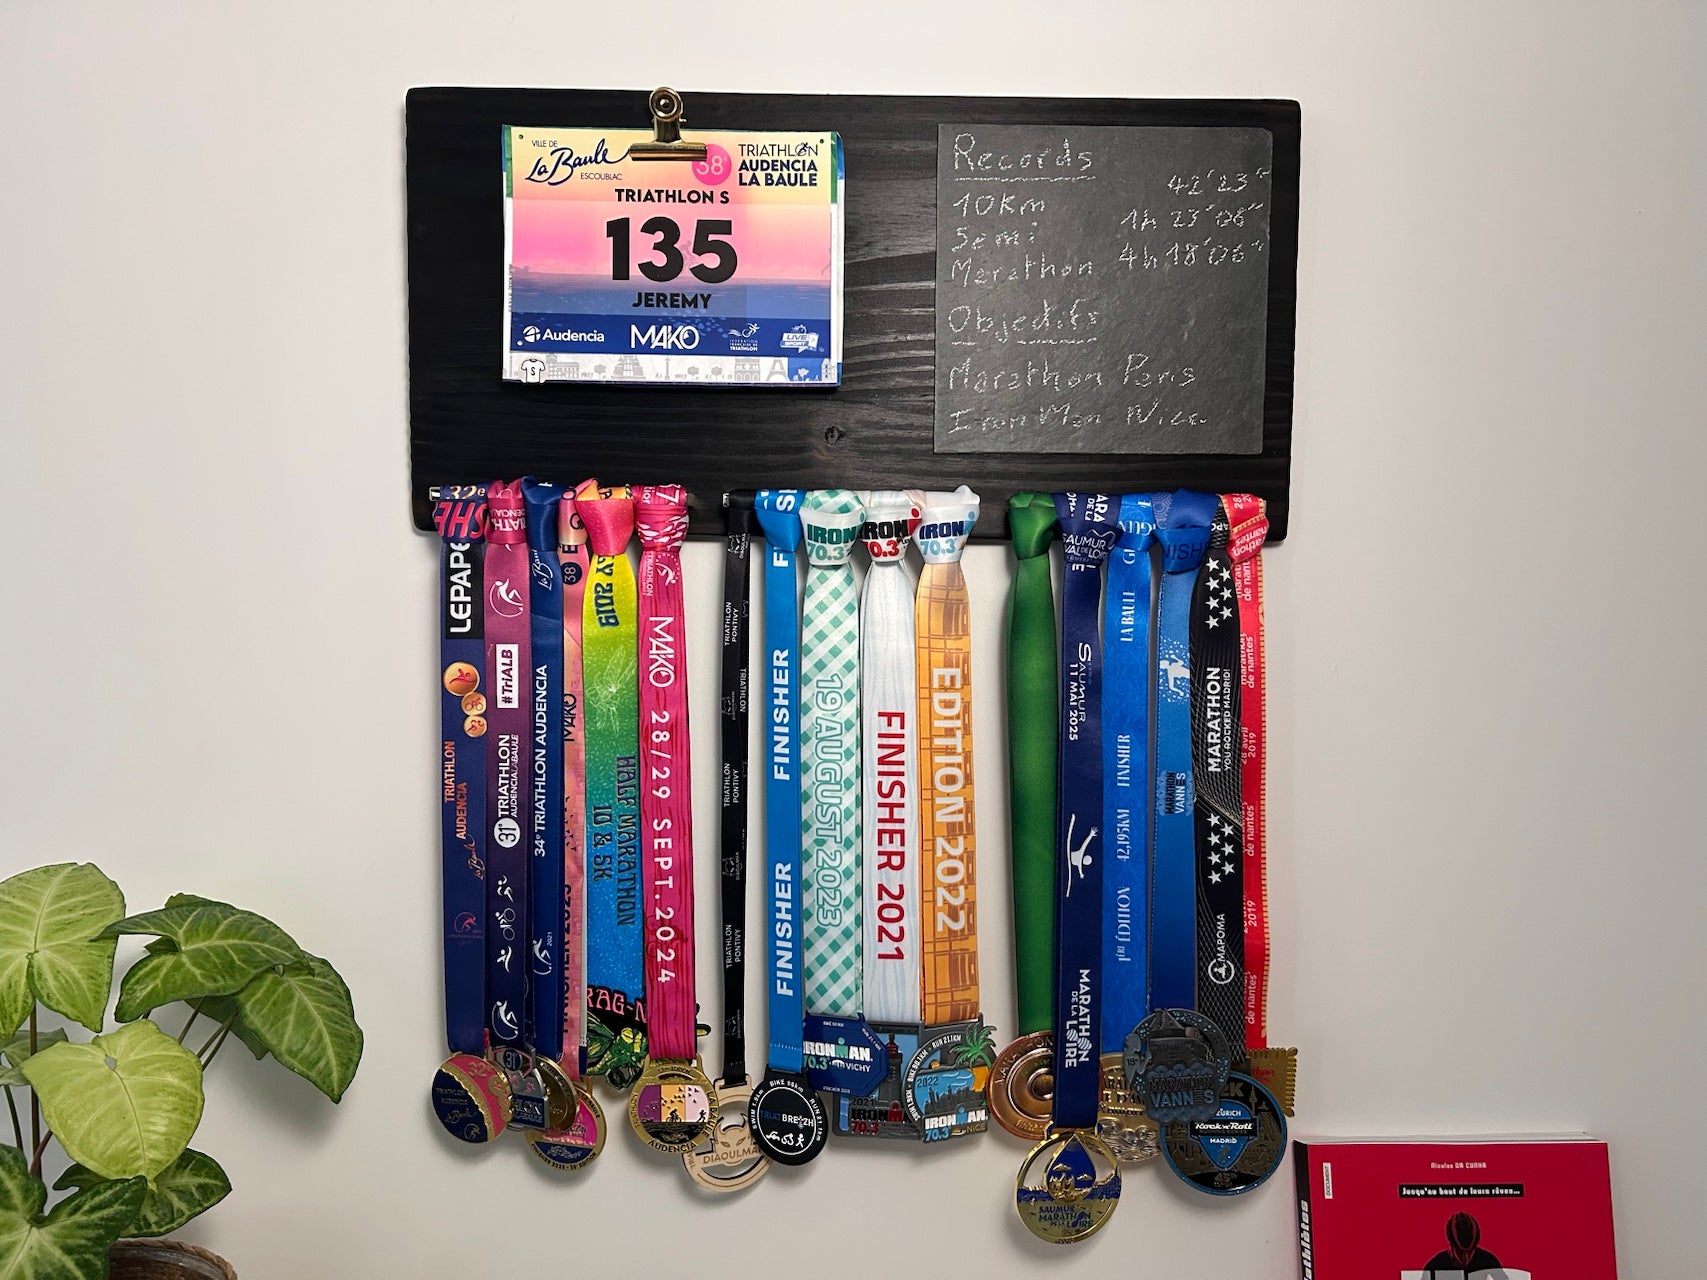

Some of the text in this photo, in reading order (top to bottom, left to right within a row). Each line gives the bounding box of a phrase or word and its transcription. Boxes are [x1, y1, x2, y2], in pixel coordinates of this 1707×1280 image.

[531, 139, 558, 148] VILLE DE
[739, 142, 818, 158] TRIATHLON
[953, 133, 1093, 172] Records
[524, 138, 630, 186] La Baule
[580, 172, 623, 181] ESCOUBLAC
[738, 159, 818, 173] AUDENCIA
[615, 188, 730, 205] TRIATHLON S
[738, 173, 818, 187] LA BAULE
[606, 216, 738, 284] 135
[951, 221, 1038, 253] Semi
[950, 251, 1093, 287] Marathon
[1118, 242, 1158, 270] 4h
[632, 291, 712, 310] JEREMY
[542, 328, 605, 343] Audencia
[630, 324, 700, 350] MAKO
[530, 366, 536, 376] S
[949, 353, 1197, 393] Marathon Paris
[808, 542, 844, 561] 70.3
[919, 538, 956, 556] 70.3
[564, 566, 577, 583] 38
[594, 581, 620, 629] 2019
[1242, 588, 1252, 601] de
[724, 601, 732, 646] TRIATHLON
[731, 607, 739, 643] PONTIVY
[1120, 590, 1135, 642] LA BAULE
[648, 616, 675, 688] MAKO
[501, 648, 513, 705] #TriALB
[739, 667, 747, 713] TRIATHLON
[1078, 643, 1092, 723] SAUMUR
[1247, 674, 1254, 689] de
[535, 664, 548, 746] AUDENCIA
[773, 648, 790, 781] FINISHER
[1068, 662, 1079, 741] 11 MAI 2025
[1206, 667, 1221, 773] MARATHON
[1223, 668, 1231, 772] YOU ROCKED MADRID!
[1116, 733, 1131, 788] FINISHER
[1247, 732, 1256, 758] 2019
[444, 740, 456, 803] TRIATHLON
[498, 734, 511, 818] TRIATHLON
[723, 763, 731, 808] TRIATHLON
[732, 768, 740, 804] PONTIVY
[534, 749, 547, 833] TRIATHLON
[815, 673, 843, 927] 19 AUGUST 2023
[933, 667, 966, 933] EDITION 2022
[1164, 772, 1176, 816] MARATHON
[1175, 772, 1187, 815] VANNES
[455, 782, 467, 840] AUDENCIA
[592, 804, 612, 825] 10
[616, 755, 638, 927] HALF MARATHON
[877, 711, 905, 960] FINISHER 2021
[1247, 843, 1254, 857] de
[775, 862, 794, 997] FINISHER
[1247, 899, 1257, 927] 2019
[725, 923, 733, 969] TRIATHLON
[1216, 913, 1226, 962] MAPOMA
[1071, 991, 1078, 1003] DE
[1071, 1005, 1078, 1017] LA
[1247, 974, 1257, 1025] de nantes
[1078, 968, 1093, 1062] MARATHON
[931, 1039, 943, 1049] RUN
[769, 1079, 786, 1088] BIKE
[845, 1063, 871, 1073] VICHY
[917, 1076, 938, 1087] 2022
[1149, 1075, 1215, 1092] MARATHON
[702, 1091, 718, 1138] LA BAULE
[809, 1098, 820, 1115] RUN
[851, 1097, 875, 1107] 2021
[1150, 1090, 1215, 1107] VANNES
[750, 1110, 758, 1130] SWIM
[925, 1127, 949, 1141] 70.3
[967, 1123, 986, 1133] NICE
[648, 1140, 697, 1153] AUDENCIA
[1402, 1187, 1437, 1197] Jusqu'au
[1439, 1187, 1456, 1195] bout
[1458, 1187, 1468, 1195] de
[1470, 1187, 1490, 1195] leurs
[1039, 1205, 1075, 1214] SAUMUR
[1039, 1211, 1091, 1221] MARATHON
